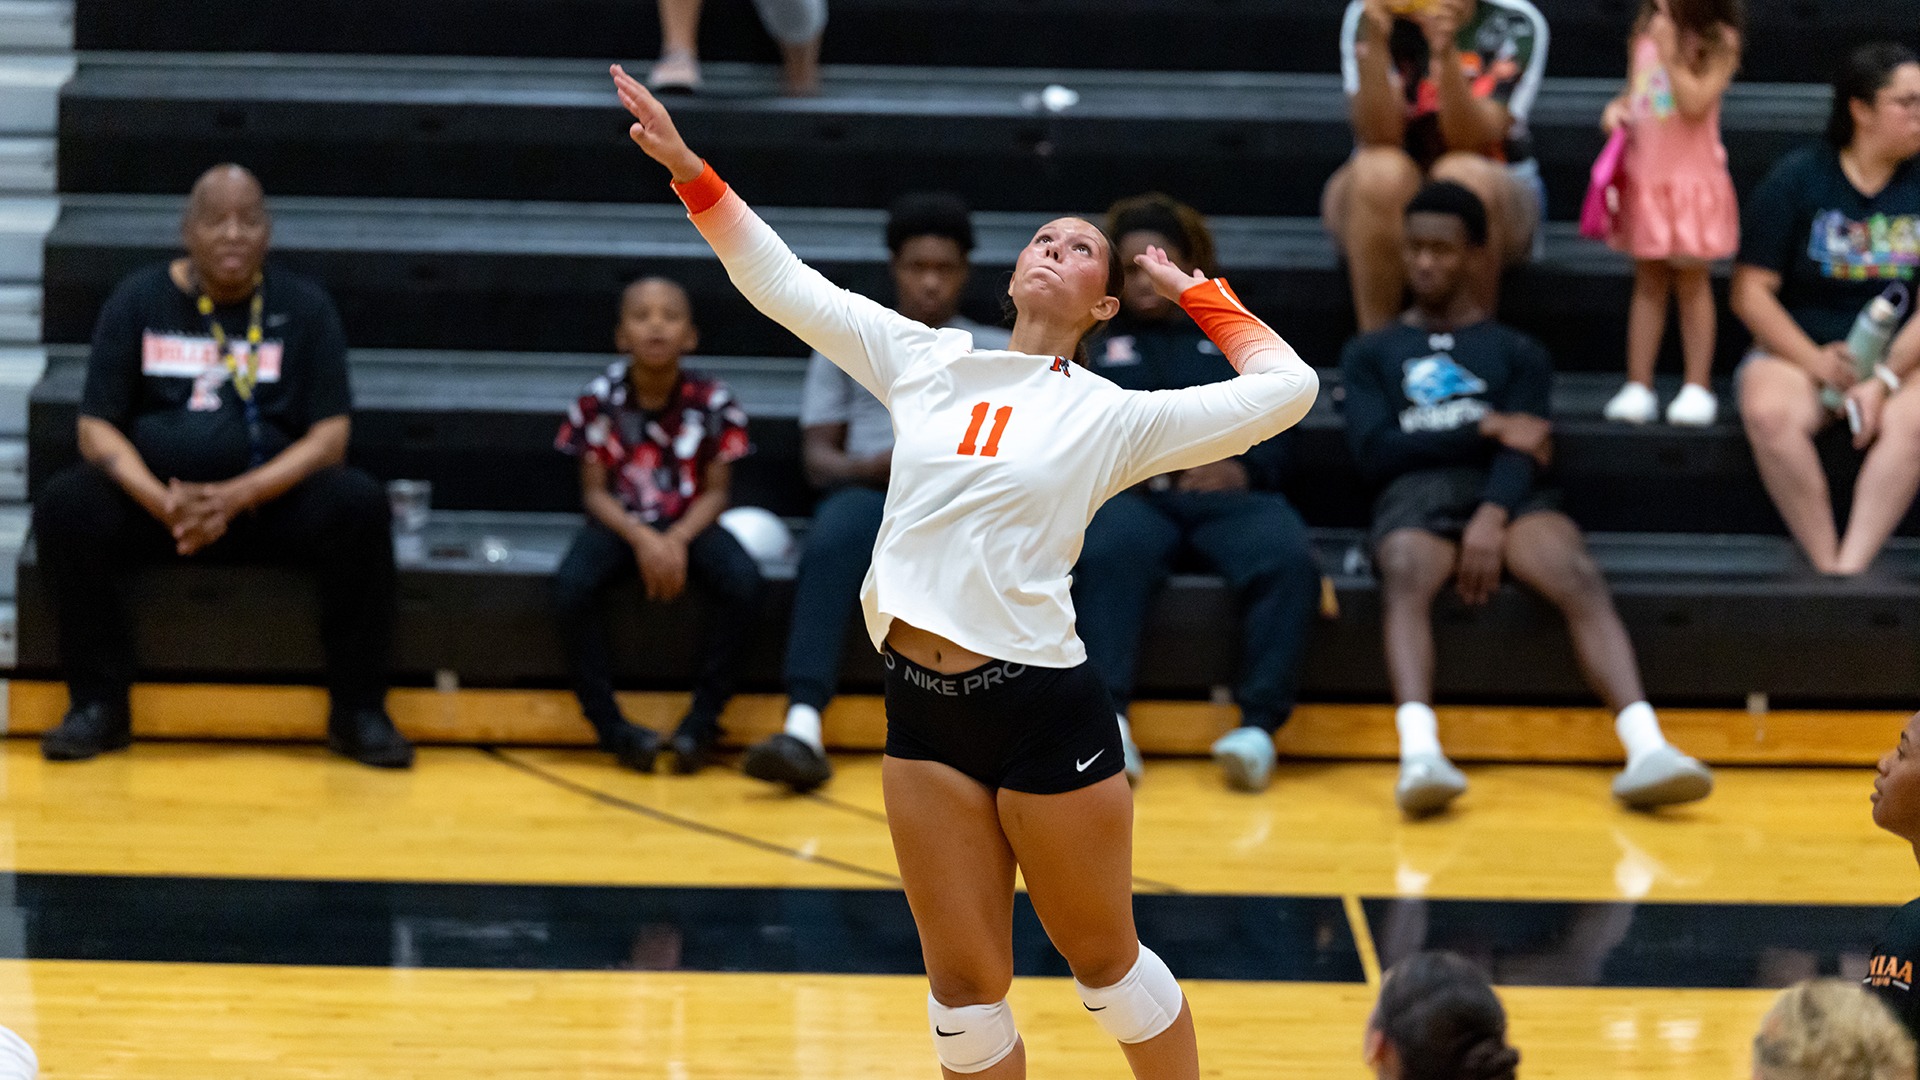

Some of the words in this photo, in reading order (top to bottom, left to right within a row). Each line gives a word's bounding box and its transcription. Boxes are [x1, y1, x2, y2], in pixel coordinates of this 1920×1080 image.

[957, 401, 1013, 457] 11
[903, 665, 959, 696] NIKE
[963, 662, 1026, 695] PRO
